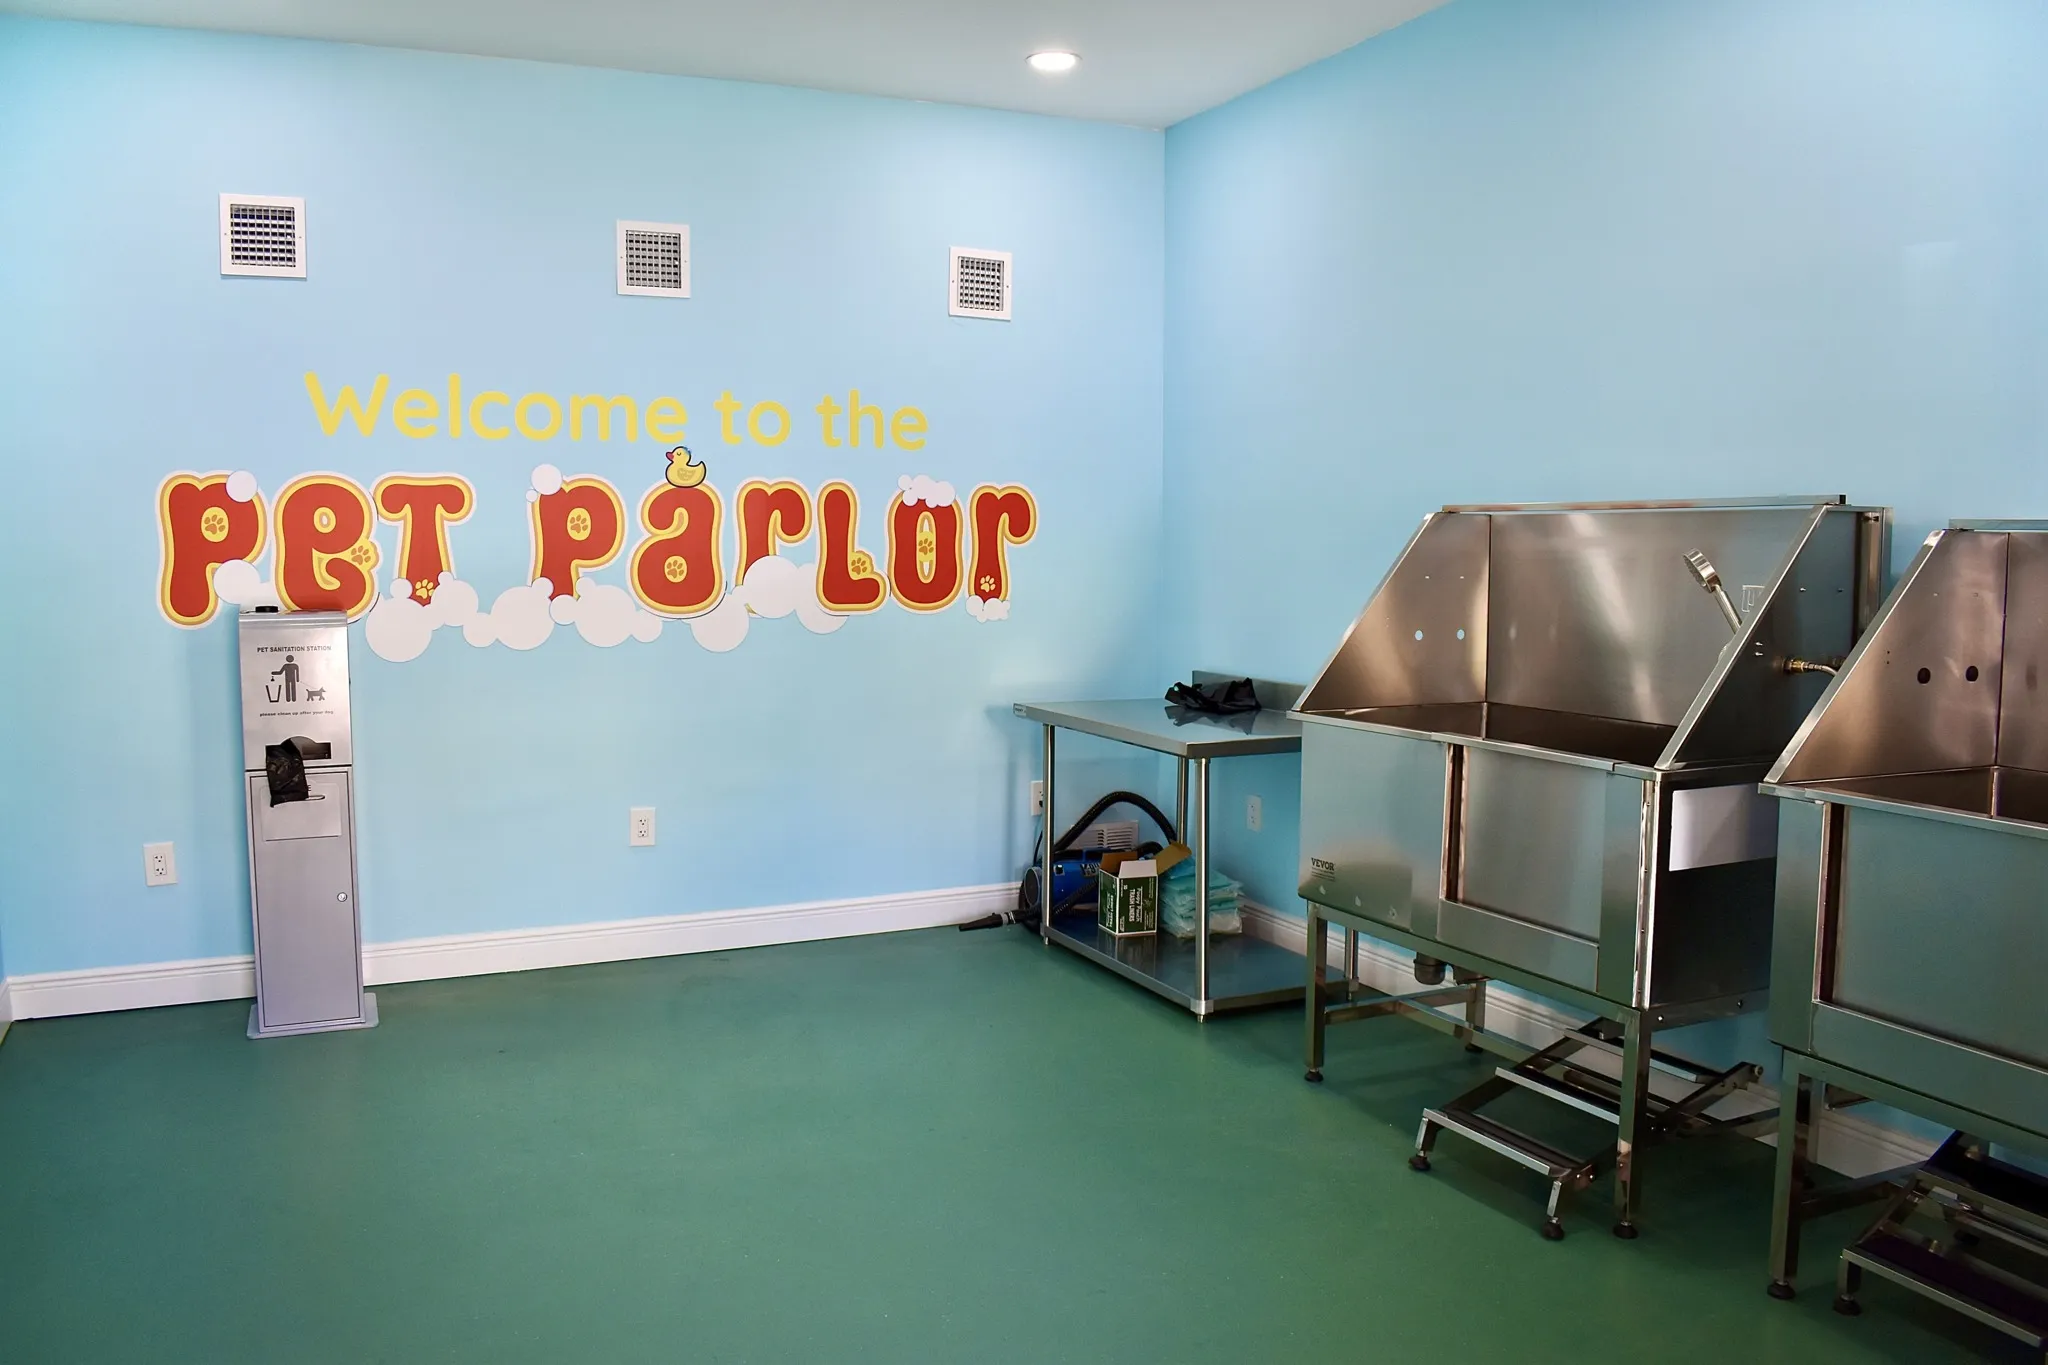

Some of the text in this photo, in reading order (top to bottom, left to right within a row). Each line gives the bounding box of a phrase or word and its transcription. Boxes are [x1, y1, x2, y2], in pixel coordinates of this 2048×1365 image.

[304, 371, 929, 451] Welcome to the
[1311, 857, 1335, 872] VEVOR
